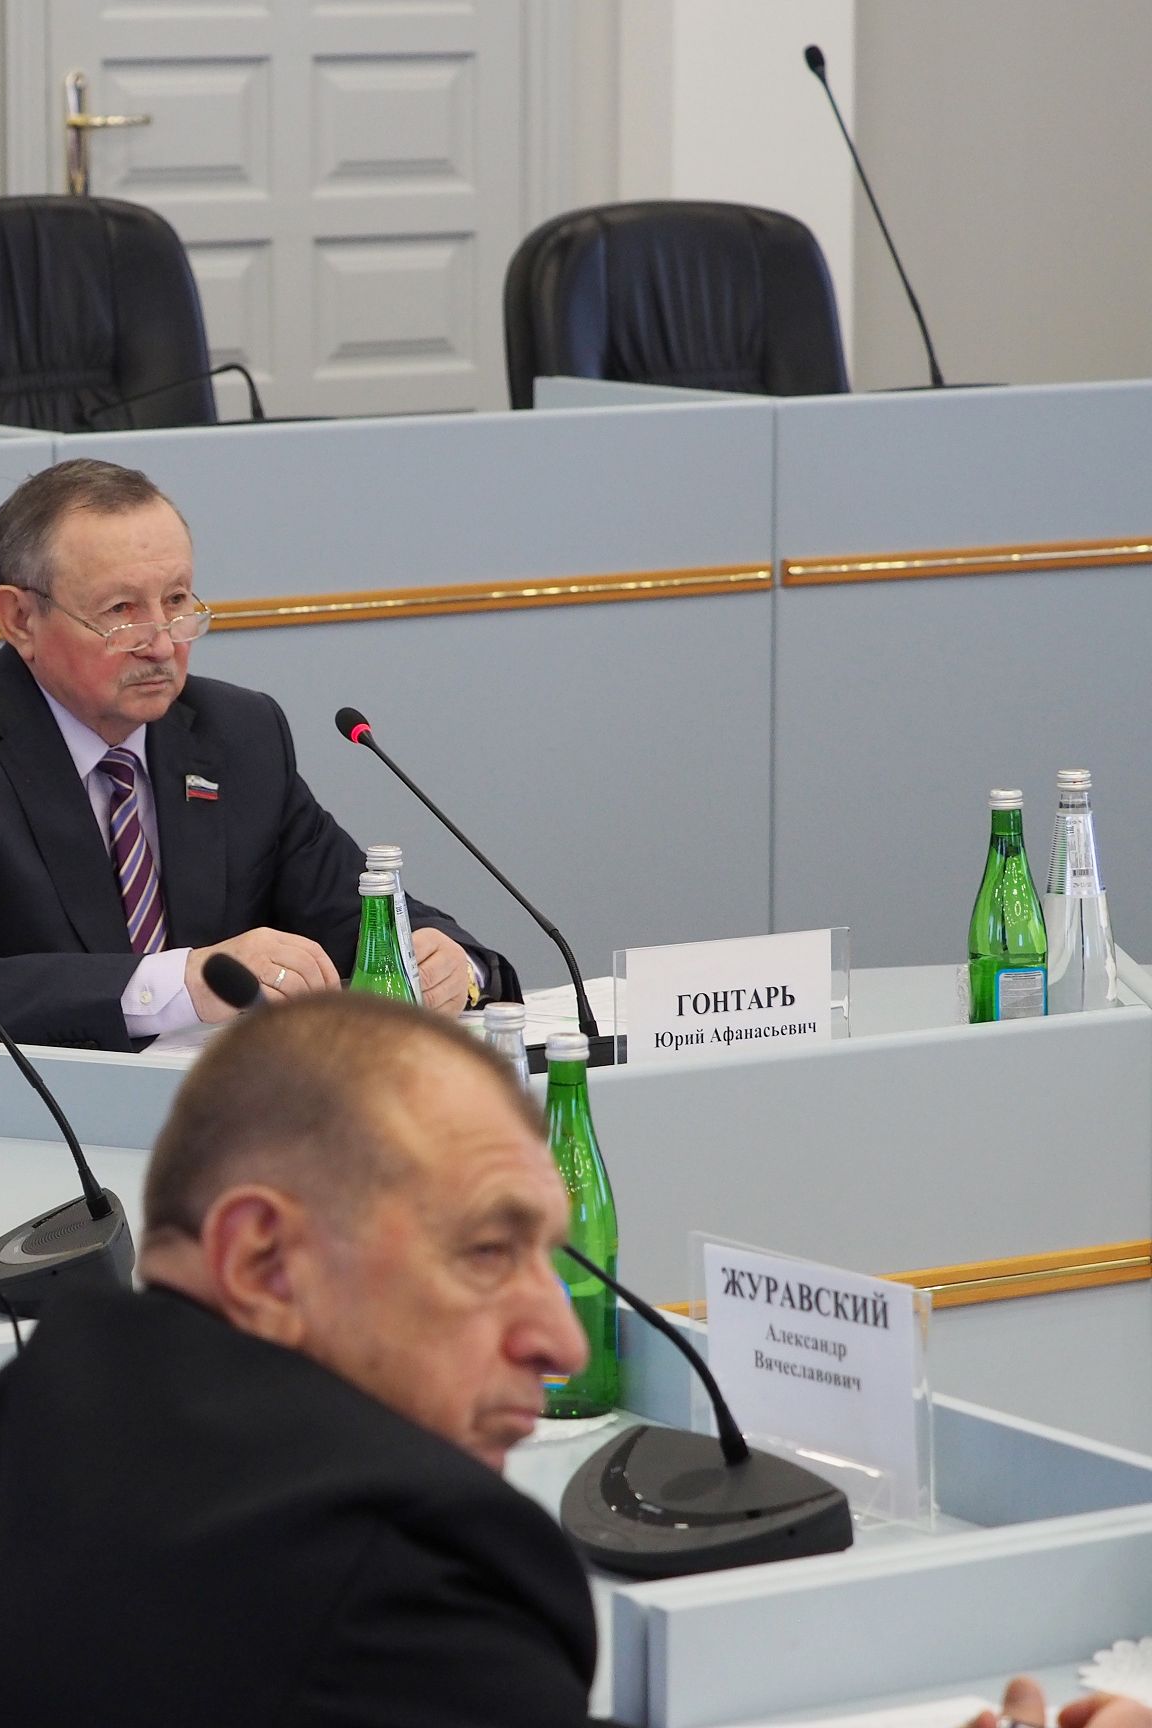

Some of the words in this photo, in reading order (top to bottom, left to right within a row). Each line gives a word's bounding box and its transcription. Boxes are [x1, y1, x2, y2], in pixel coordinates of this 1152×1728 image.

[677, 985, 795, 1016] ГОНТАРЬ
[655, 1029, 704, 1051] Юрий
[710, 1022, 817, 1046] Афанасьевич
[721, 1267, 890, 1330] ЖУРАВСКИЙ
[765, 1324, 847, 1361] Александр
[754, 1350, 861, 1391] Вячеславович
